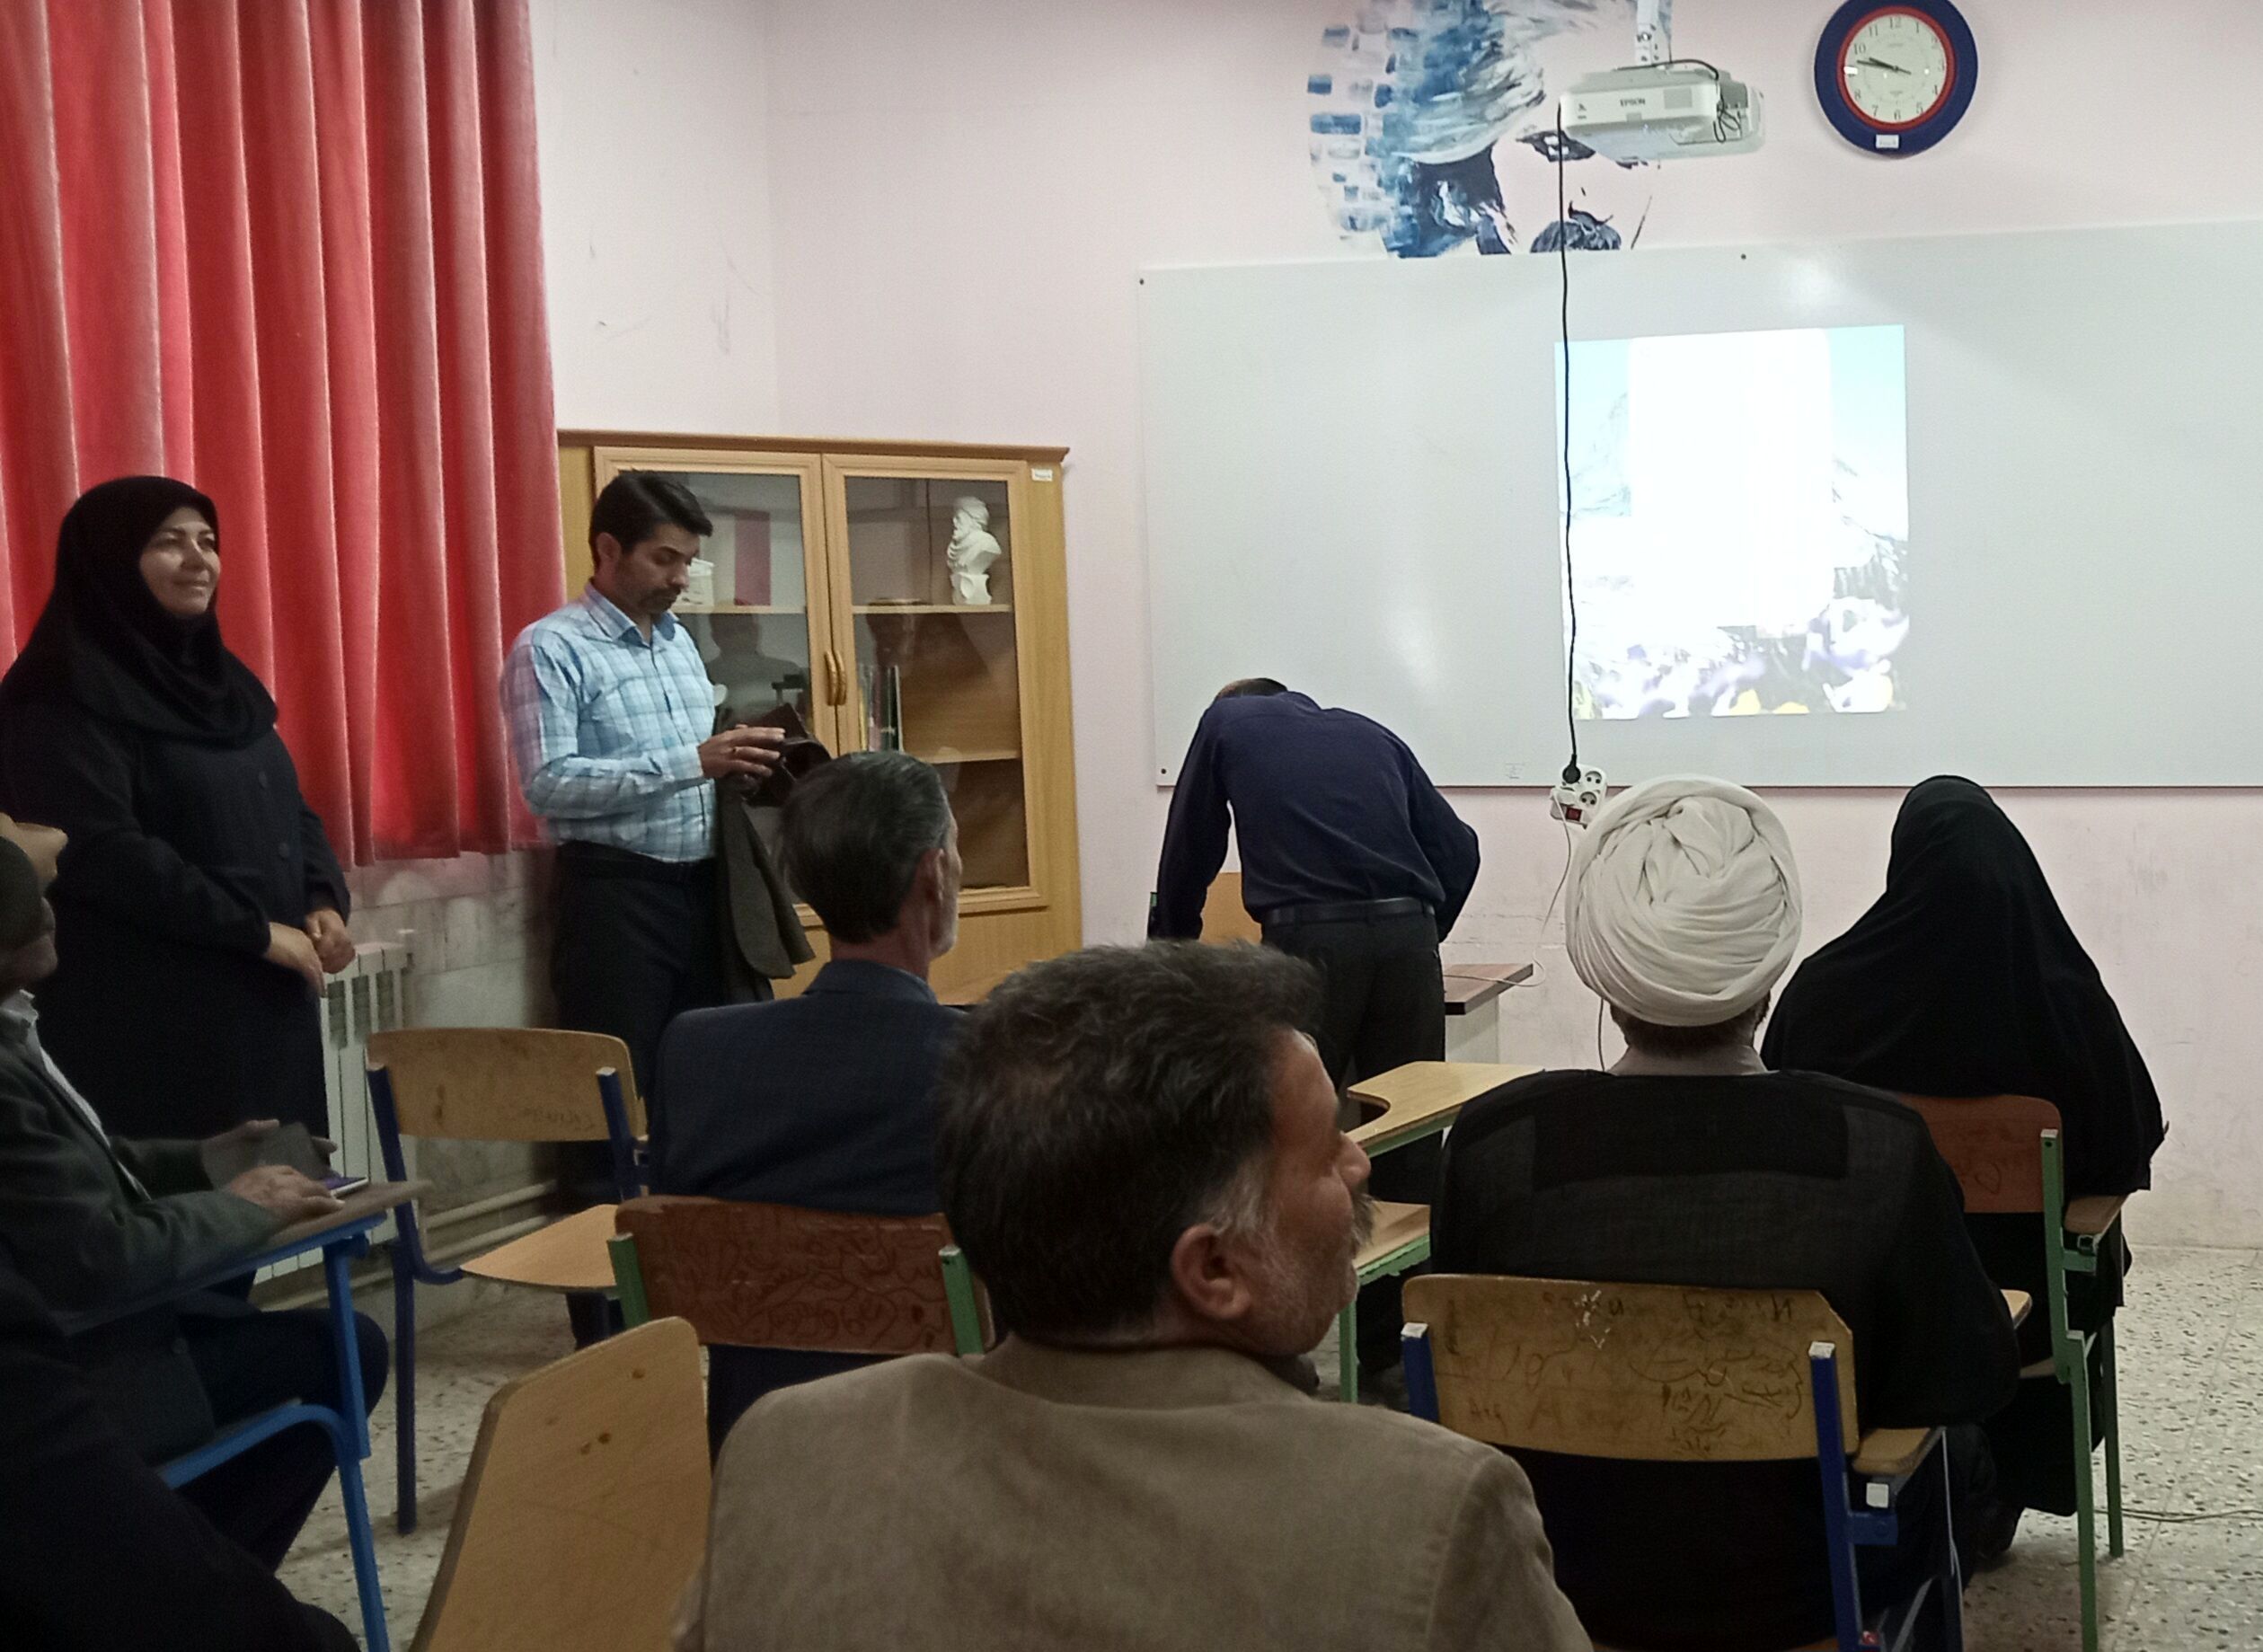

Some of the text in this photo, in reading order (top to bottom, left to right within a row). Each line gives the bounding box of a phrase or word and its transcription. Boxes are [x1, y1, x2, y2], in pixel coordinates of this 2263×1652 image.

[1889, 17, 1901, 30] 12
[1915, 22, 1920, 33] 1
[1870, 25, 1878, 38] 11
[1854, 43, 1866, 56] 10
[1854, 89, 1861, 100] 8
[1621, 98, 1645, 107] EPSON
[1916, 102, 1923, 114] 5
[1872, 104, 1878, 117] 7
[1895, 110, 1901, 120] 6
